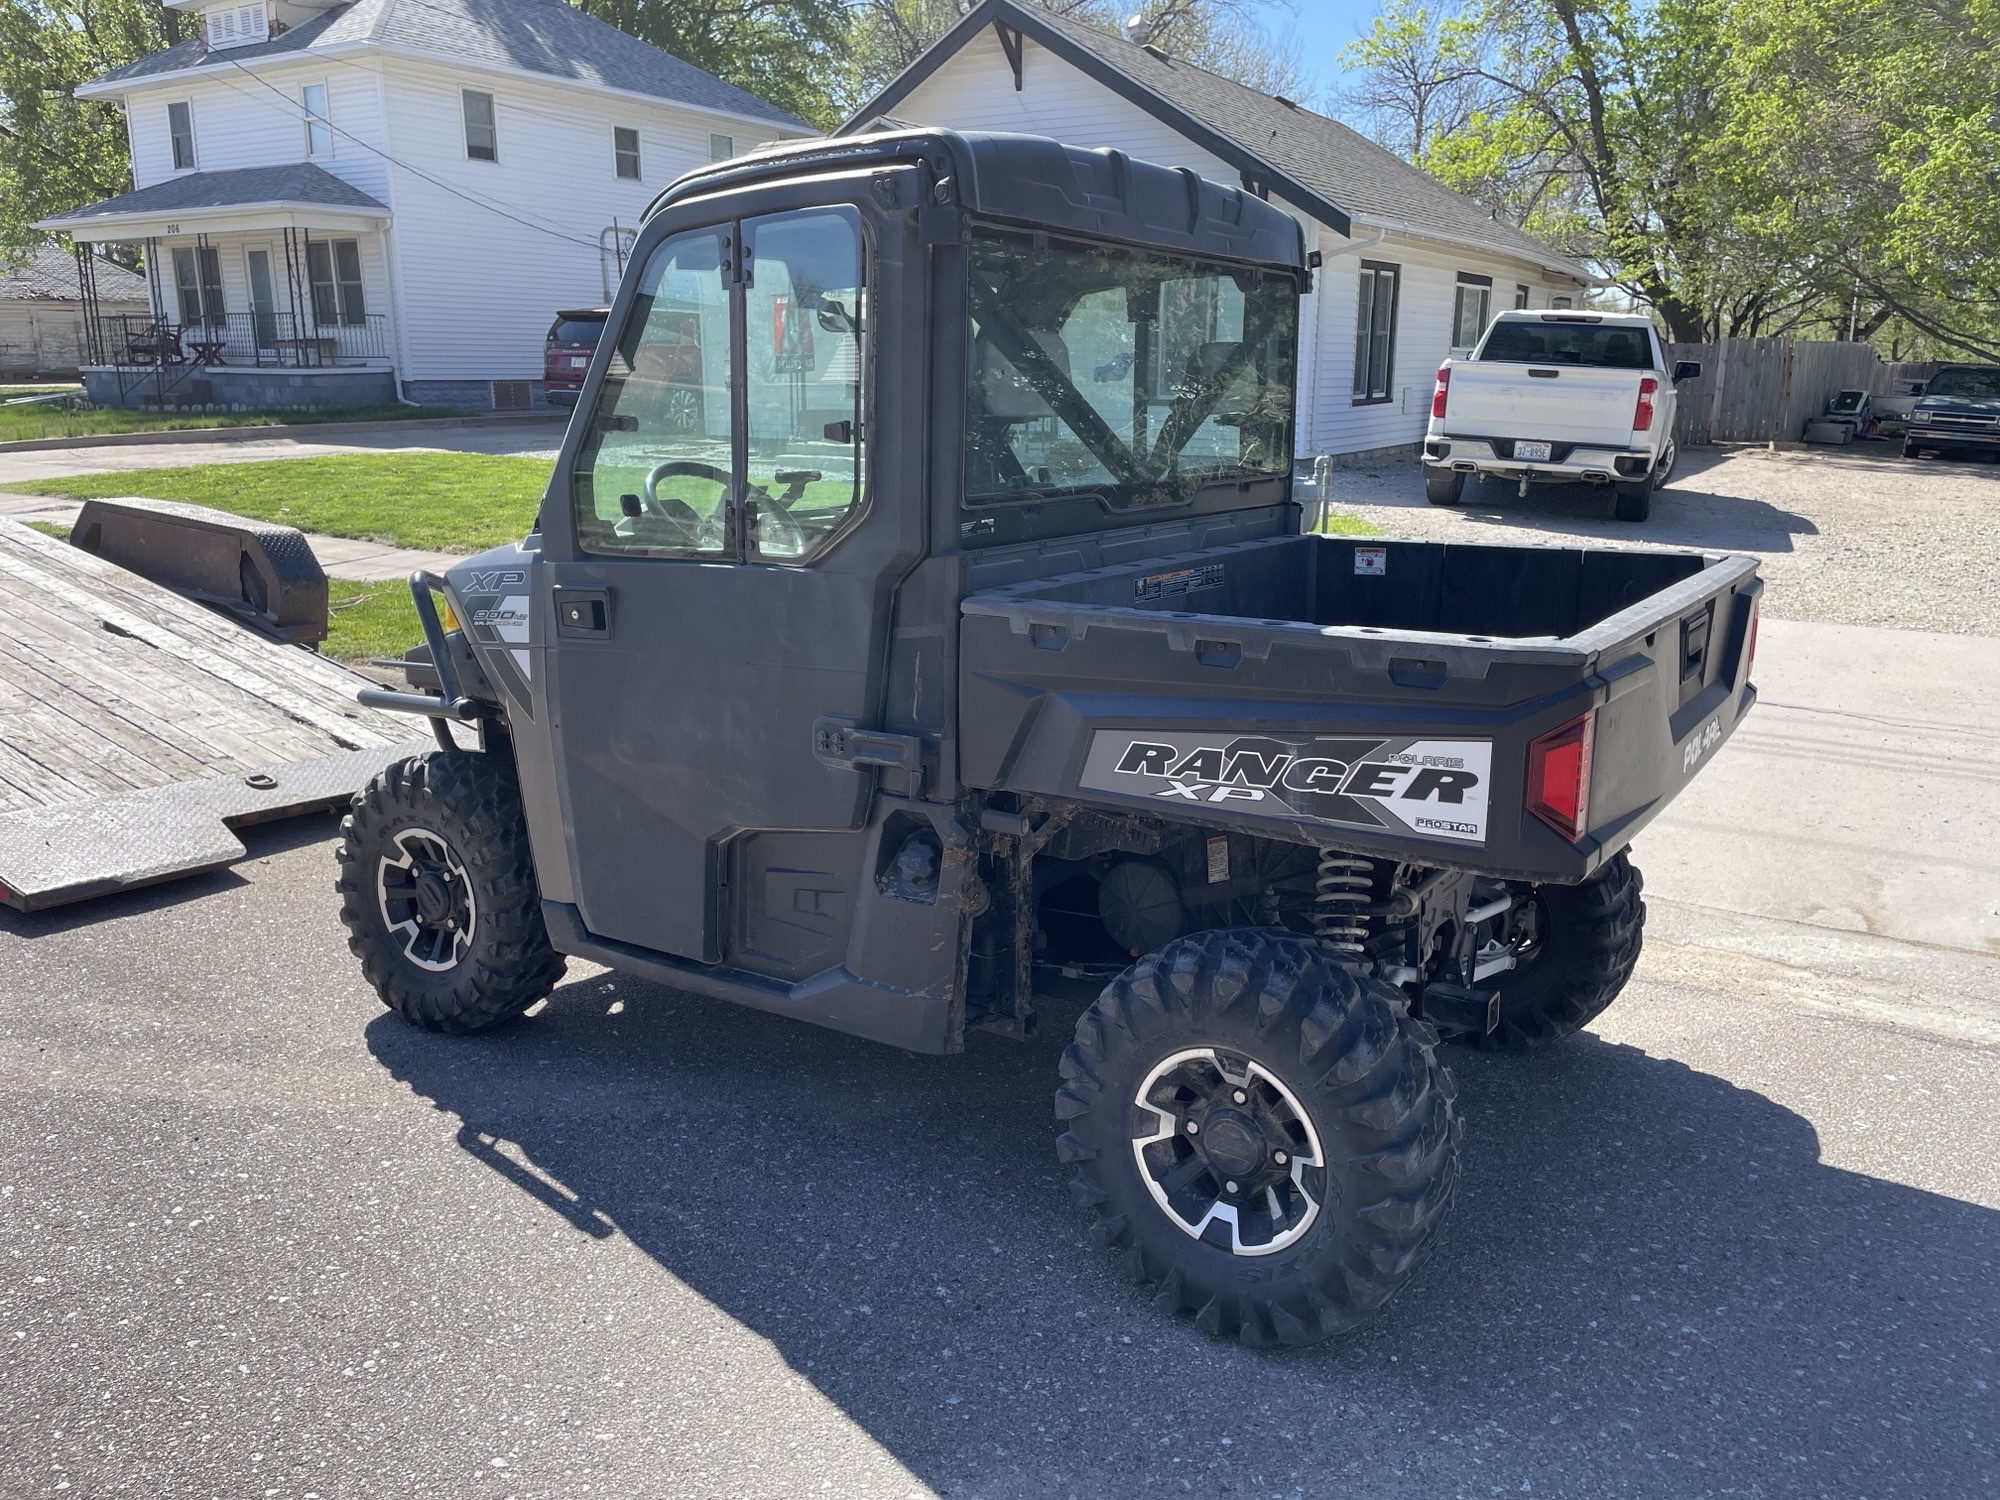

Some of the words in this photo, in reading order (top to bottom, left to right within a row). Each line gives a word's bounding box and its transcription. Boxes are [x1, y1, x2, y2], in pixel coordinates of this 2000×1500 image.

[167, 224, 180, 234] 206
[461, 570, 526, 592] XP
[473, 609, 516, 621] 900
[1388, 753, 1464, 769] POLARIS
[1114, 740, 1479, 804] RANGER
[1154, 780, 1266, 803] XP
[1415, 816, 1478, 834] PROSTAR
